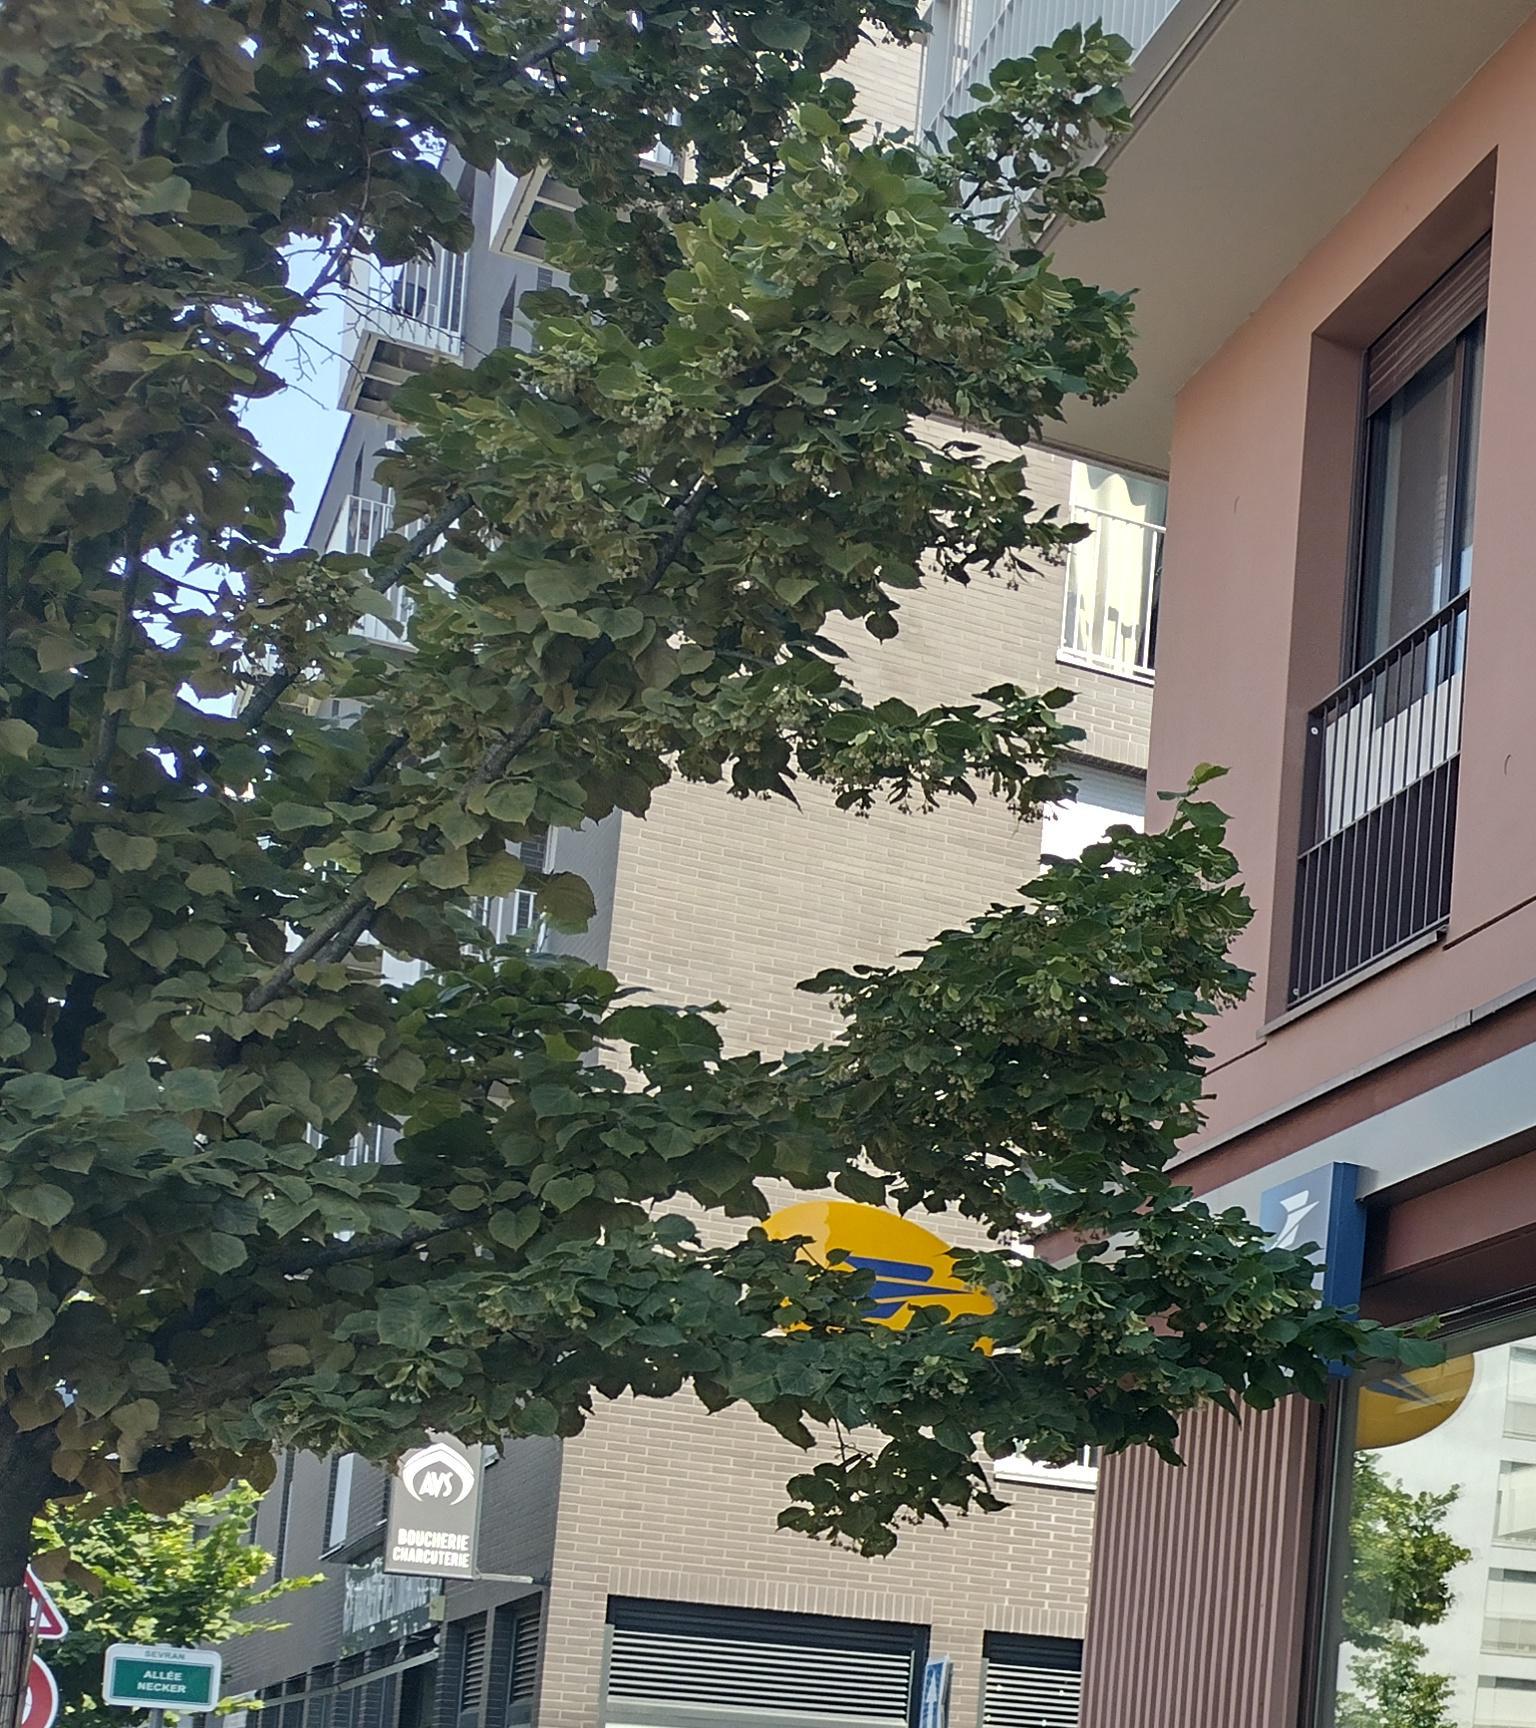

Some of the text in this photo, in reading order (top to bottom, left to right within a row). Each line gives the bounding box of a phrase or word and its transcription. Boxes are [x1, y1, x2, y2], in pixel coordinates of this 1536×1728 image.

[398, 1528, 470, 1552] BOUCHERIE
[392, 1546, 470, 1568] CHARCUTERIE
[144, 1650, 186, 1660] SEVRAN
[143, 1670, 183, 1681] ALLÉE
[137, 1682, 186, 1693] NECKER
